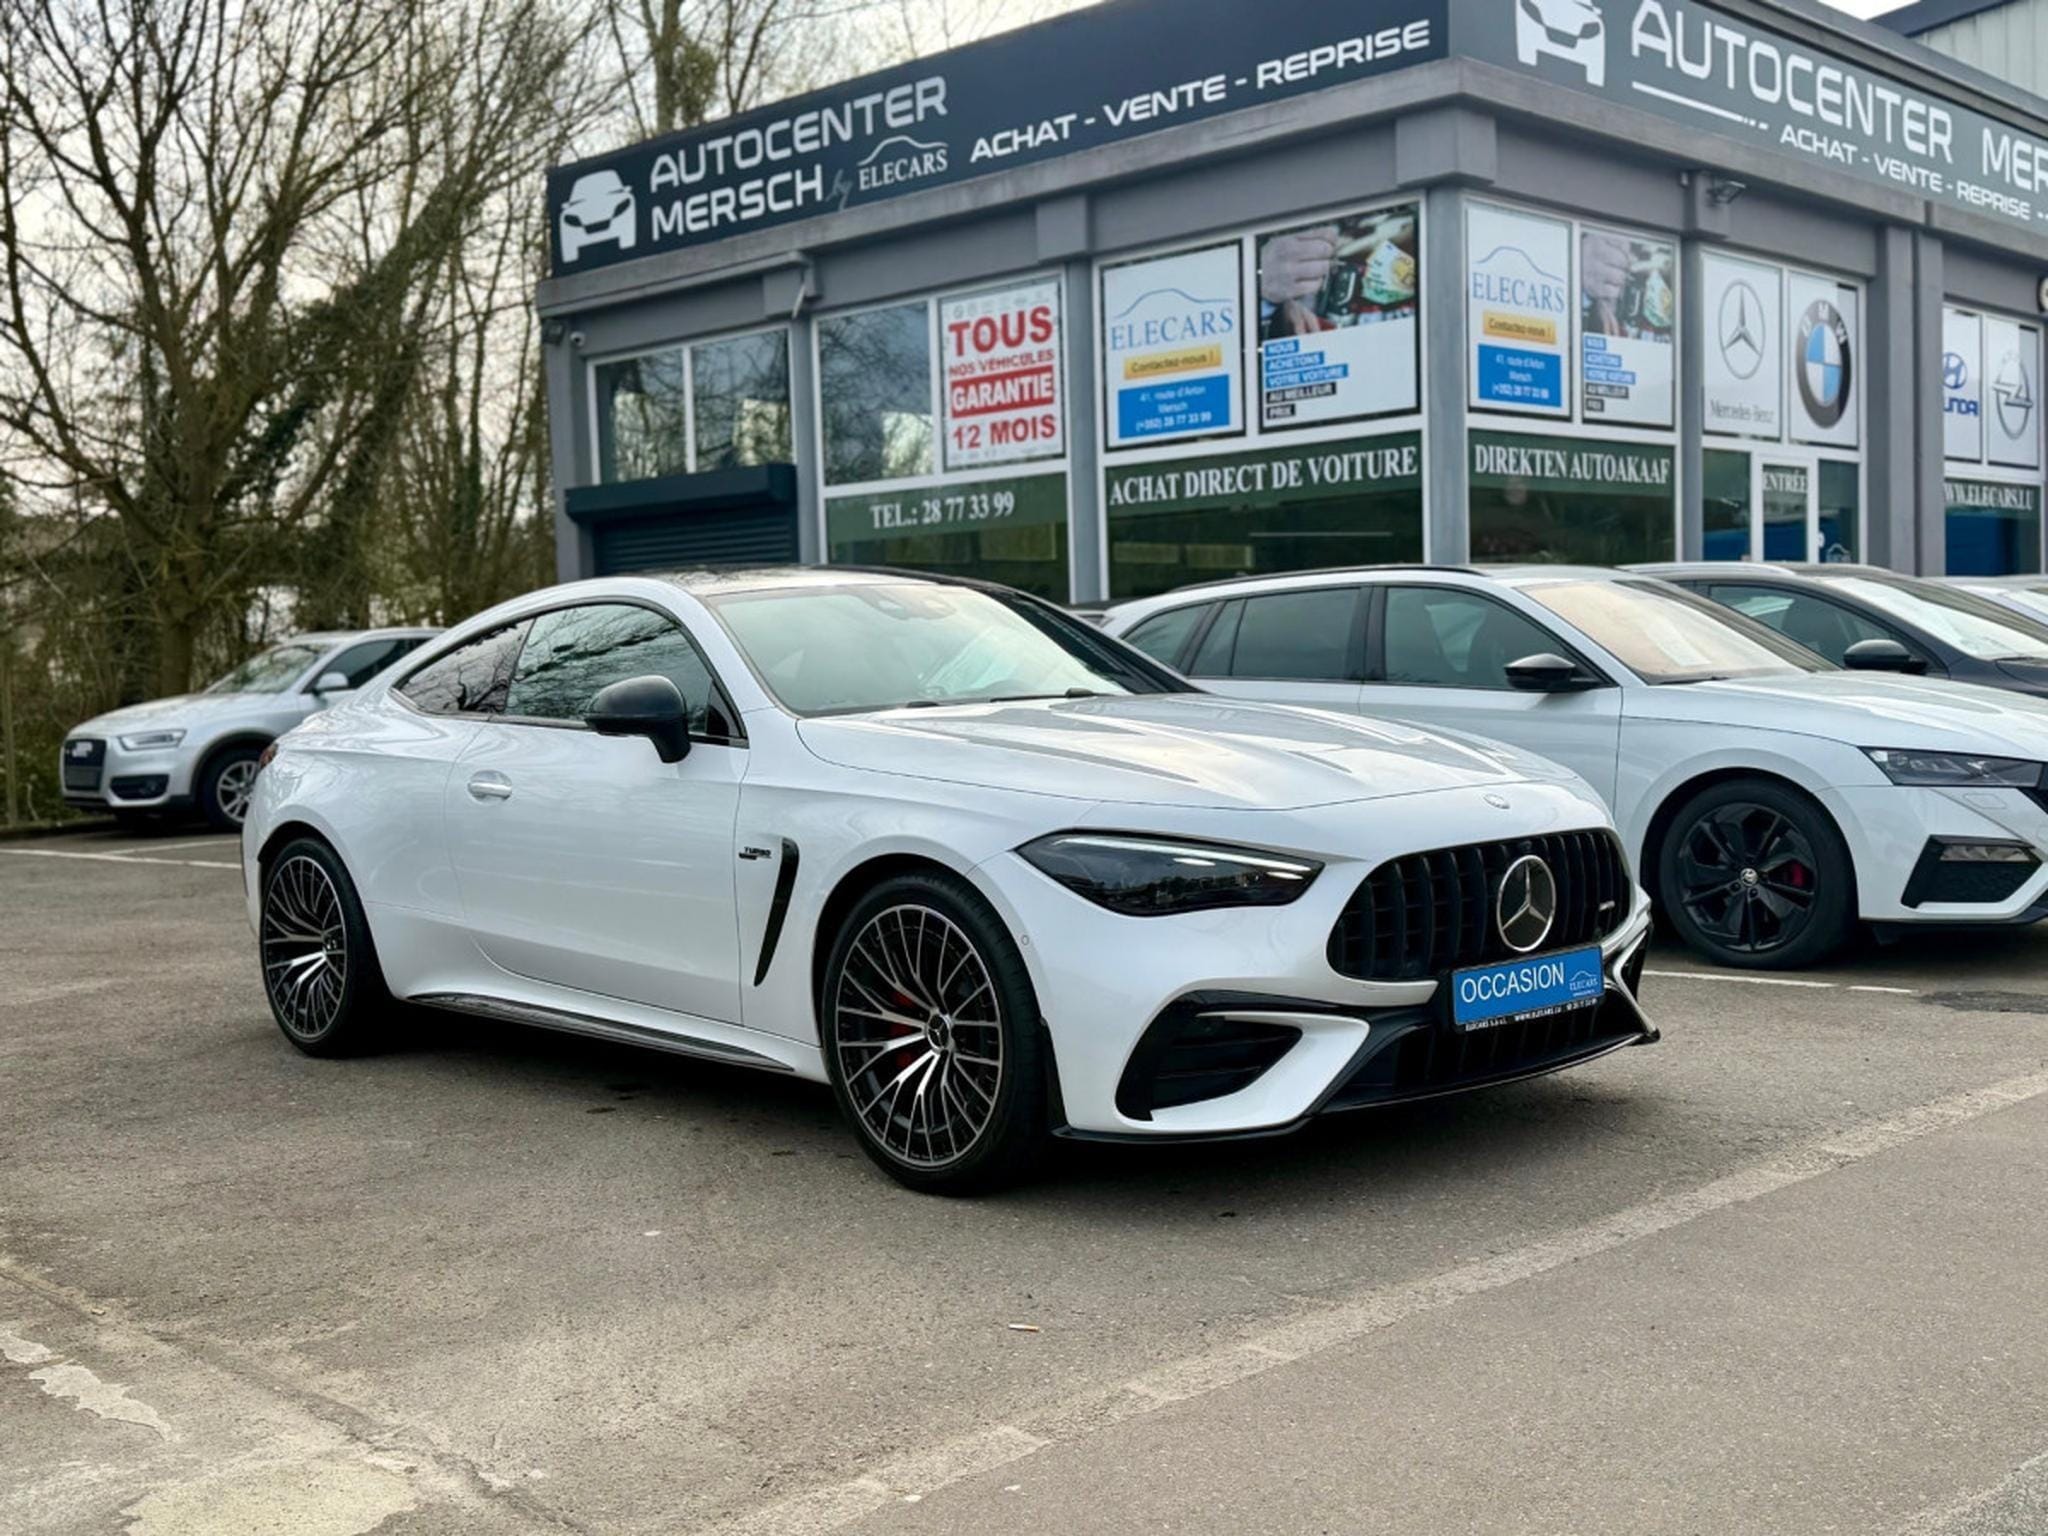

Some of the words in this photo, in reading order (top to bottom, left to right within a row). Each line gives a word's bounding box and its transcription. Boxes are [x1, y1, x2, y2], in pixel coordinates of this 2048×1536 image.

[970, 114, 1078, 163] ACHAT
[1103, 74, 1227, 126] VENTE
[1256, 19, 1431, 88] REPRISE
[1631, 0, 1951, 162] AUTOCENTER
[650, 76, 948, 193] AUTOCENTER
[1780, 123, 1859, 165] ACHAT
[1873, 152, 1943, 193] VENTE
[1957, 180, 2031, 220] REPRISE
[652, 164, 823, 240] MERSCH
[859, 148, 948, 191] ELECARS
[1472, 271, 1565, 314] ELECARS
[948, 306, 1053, 357] TOUS
[1109, 307, 1234, 351] ELECARS
[949, 362, 976, 377] NOS
[952, 372, 1054, 412] GARANTIE
[953, 424, 981, 450] 12
[990, 413, 1056, 446] MOIS
[1109, 472, 1181, 506] ACHAT
[1184, 463, 1267, 498] DIRECT
[1271, 459, 1304, 489] DE
[1307, 446, 1418, 484] VOITURE
[1474, 443, 1567, 479] DIREKTEN
[1569, 451, 1671, 484] AUTOAKAAF
[921, 498, 942, 525] 28
[945, 496, 965, 523] 77
[968, 493, 989, 520] 33
[993, 490, 1015, 518] 99
[1460, 961, 1564, 1003] OCCASION
